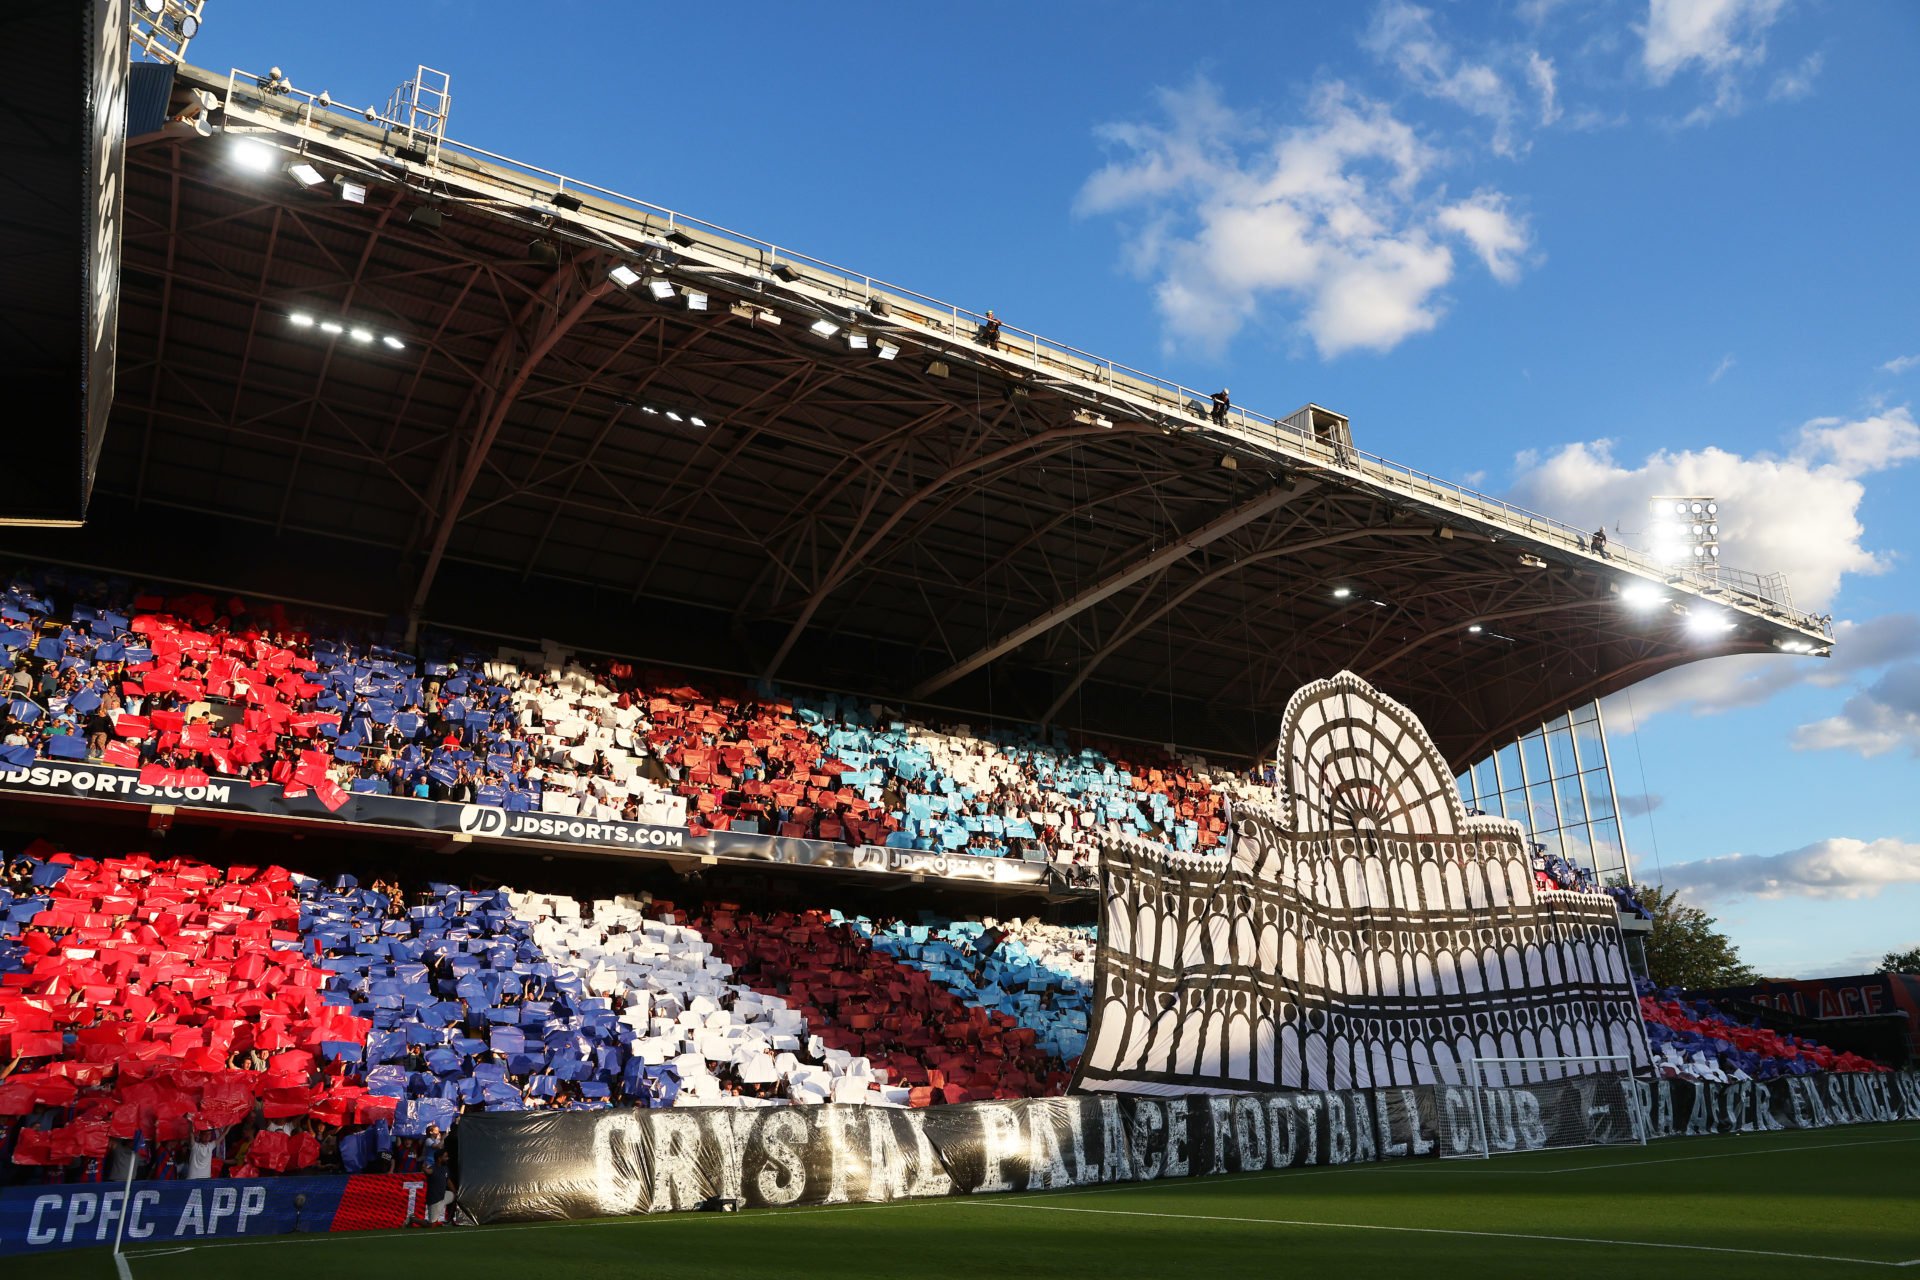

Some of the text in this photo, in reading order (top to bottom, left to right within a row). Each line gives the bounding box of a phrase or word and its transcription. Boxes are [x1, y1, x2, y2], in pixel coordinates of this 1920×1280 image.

[466, 808, 682, 847] JD JDSPORTS.COM
[890, 853, 1020, 880] JDSPORTSCOM
[592, 1108, 952, 1214] CRYSTAL
[973, 1098, 1189, 1192] PALACE
[1205, 1089, 1434, 1174] FOOTBALL
[1445, 1087, 1547, 1153] CLUB
[1685, 1080, 1785, 1136] AFTER
[1828, 1073, 1898, 1125] SINCE
[27, 1186, 266, 1246] CPFC APP
